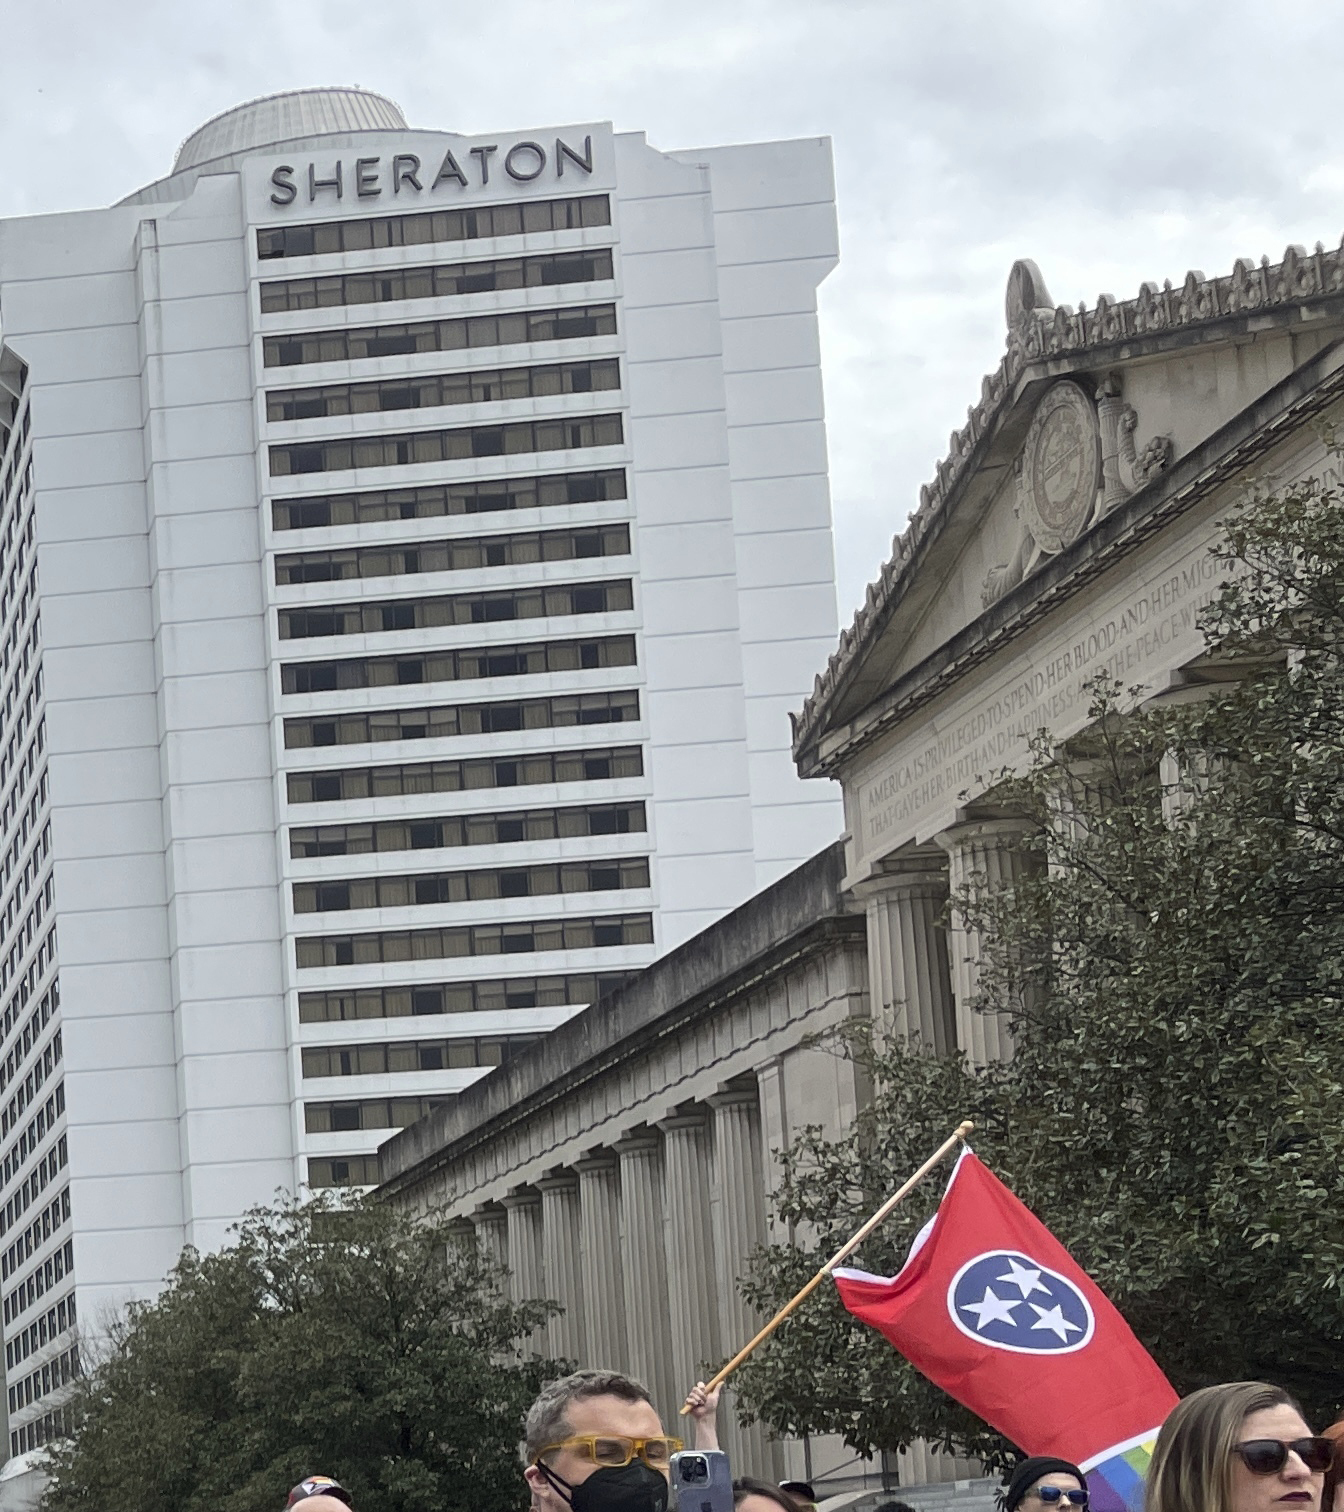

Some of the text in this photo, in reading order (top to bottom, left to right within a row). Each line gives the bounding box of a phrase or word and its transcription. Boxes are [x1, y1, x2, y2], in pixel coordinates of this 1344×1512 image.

[269, 134, 594, 206] SHERATON
[868, 763, 912, 810] AMERICA
[913, 755, 924, 781] IS
[924, 711, 986, 773] PRIVILEGED
[986, 700, 1002, 731] TO
[1003, 670, 1044, 719] SPEND
[1046, 650, 1072, 689] HER
[1073, 620, 1116, 670] BLOOD
[1119, 596, 1149, 640] AND
[1151, 575, 1183, 616] HER
[869, 805, 894, 838] THAT
[894, 787, 921, 822] GAVE
[921, 772, 945, 805] HER
[946, 748, 979, 790] BIRTH
[980, 730, 1005, 766] AND
[1006, 683, 1072, 748] HAPPINESS
[1107, 643, 1133, 681] THE
[1137, 612, 1178, 663] PEACE
